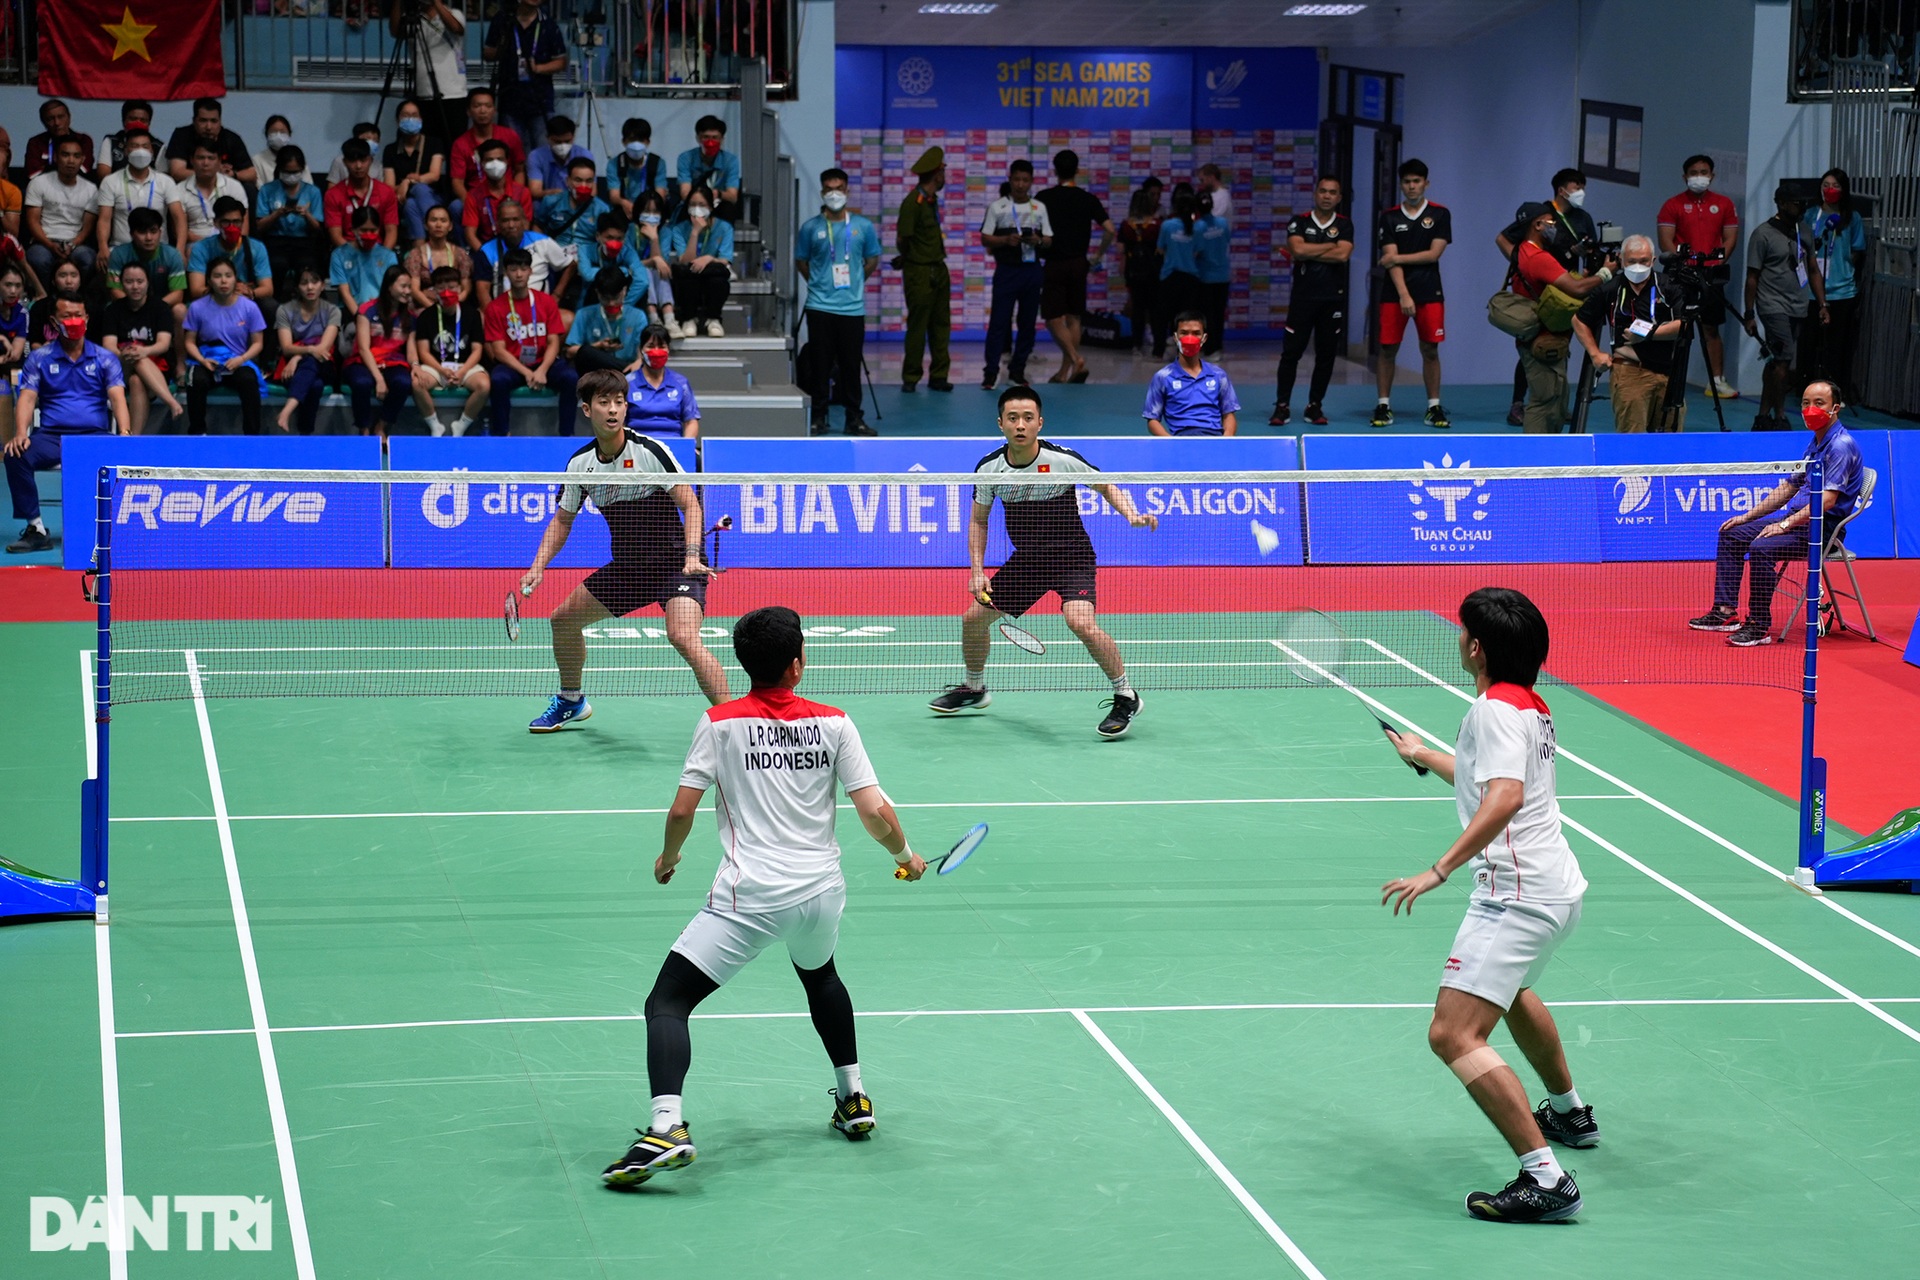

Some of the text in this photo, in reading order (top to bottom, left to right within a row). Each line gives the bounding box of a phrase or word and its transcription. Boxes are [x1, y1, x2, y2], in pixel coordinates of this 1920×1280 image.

[1034, 62, 1073, 82] SEA
[1080, 62, 1152, 82] GAMES
[999, 87, 1149, 107] VIET NAM 2021
[116, 484, 327, 530] ReVive
[482, 484, 602, 523] digi
[740, 484, 839, 534] BIA
[1615, 517, 1654, 525] VNPT
[1410, 527, 1492, 541] TUAN CHAU
[1430, 544, 1475, 552] GROUP
[748, 724, 821, 748] L R CARNANDO
[744, 750, 830, 771] INDONESIA
[1814, 806, 1824, 833] YONEX
